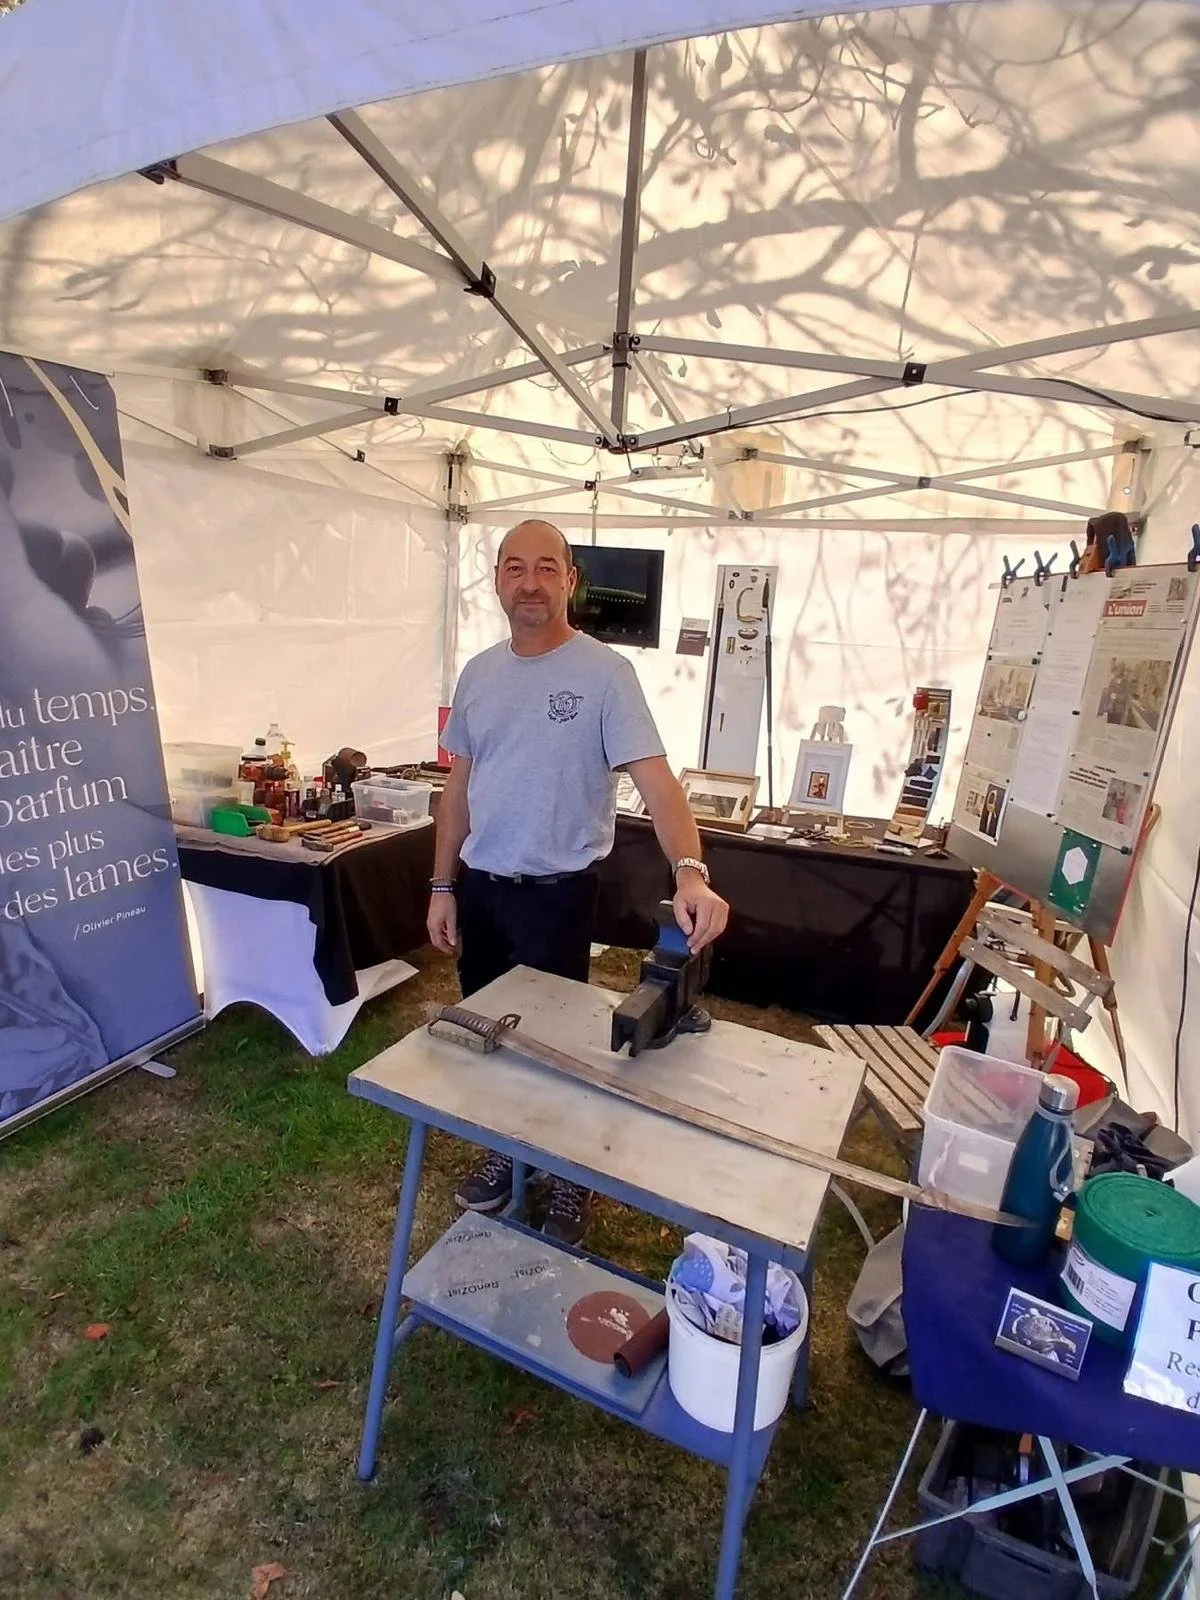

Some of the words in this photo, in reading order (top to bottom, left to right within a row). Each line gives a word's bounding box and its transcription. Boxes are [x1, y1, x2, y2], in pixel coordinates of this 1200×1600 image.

[33, 687, 154, 726] temps.
[0, 736, 84, 778] aître
[49, 829, 105, 869] plus
[5, 888, 58, 920] des
[64, 848, 178, 901] lames.
[116, 905, 147, 922] Pineau
